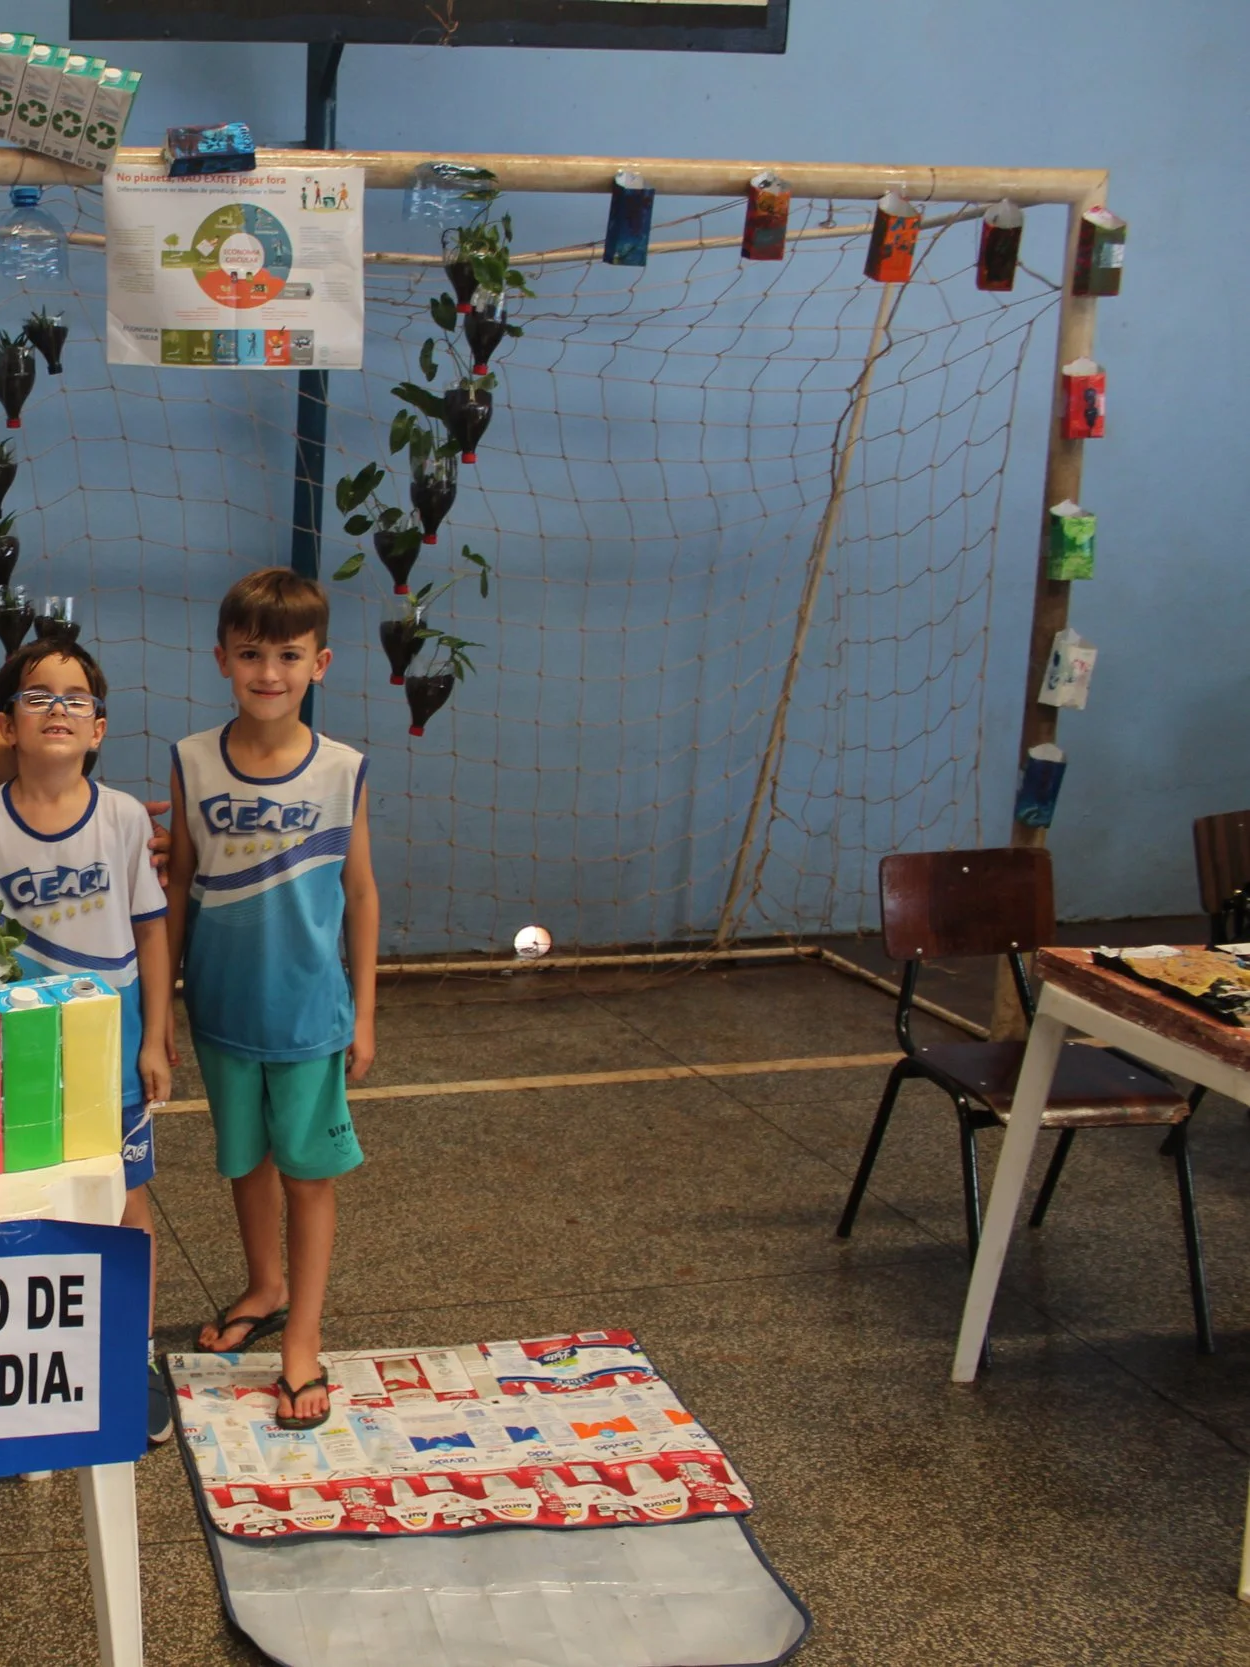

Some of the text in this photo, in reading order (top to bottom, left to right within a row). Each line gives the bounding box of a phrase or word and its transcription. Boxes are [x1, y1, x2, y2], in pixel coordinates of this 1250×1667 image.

[116, 172, 131, 182] No
[133, 172, 175, 184] planeta,
[204, 175, 237, 184] EXISTE
[239, 175, 264, 187] jogar
[266, 175, 287, 185] fora
[204, 794, 323, 833] CEART
[3, 862, 111, 905] CEART
[27, 1275, 84, 1330] DE
[493, 1502, 532, 1510] Aurora
[642, 1495, 682, 1509] Aurora
[295, 1513, 335, 1523] Aurora
